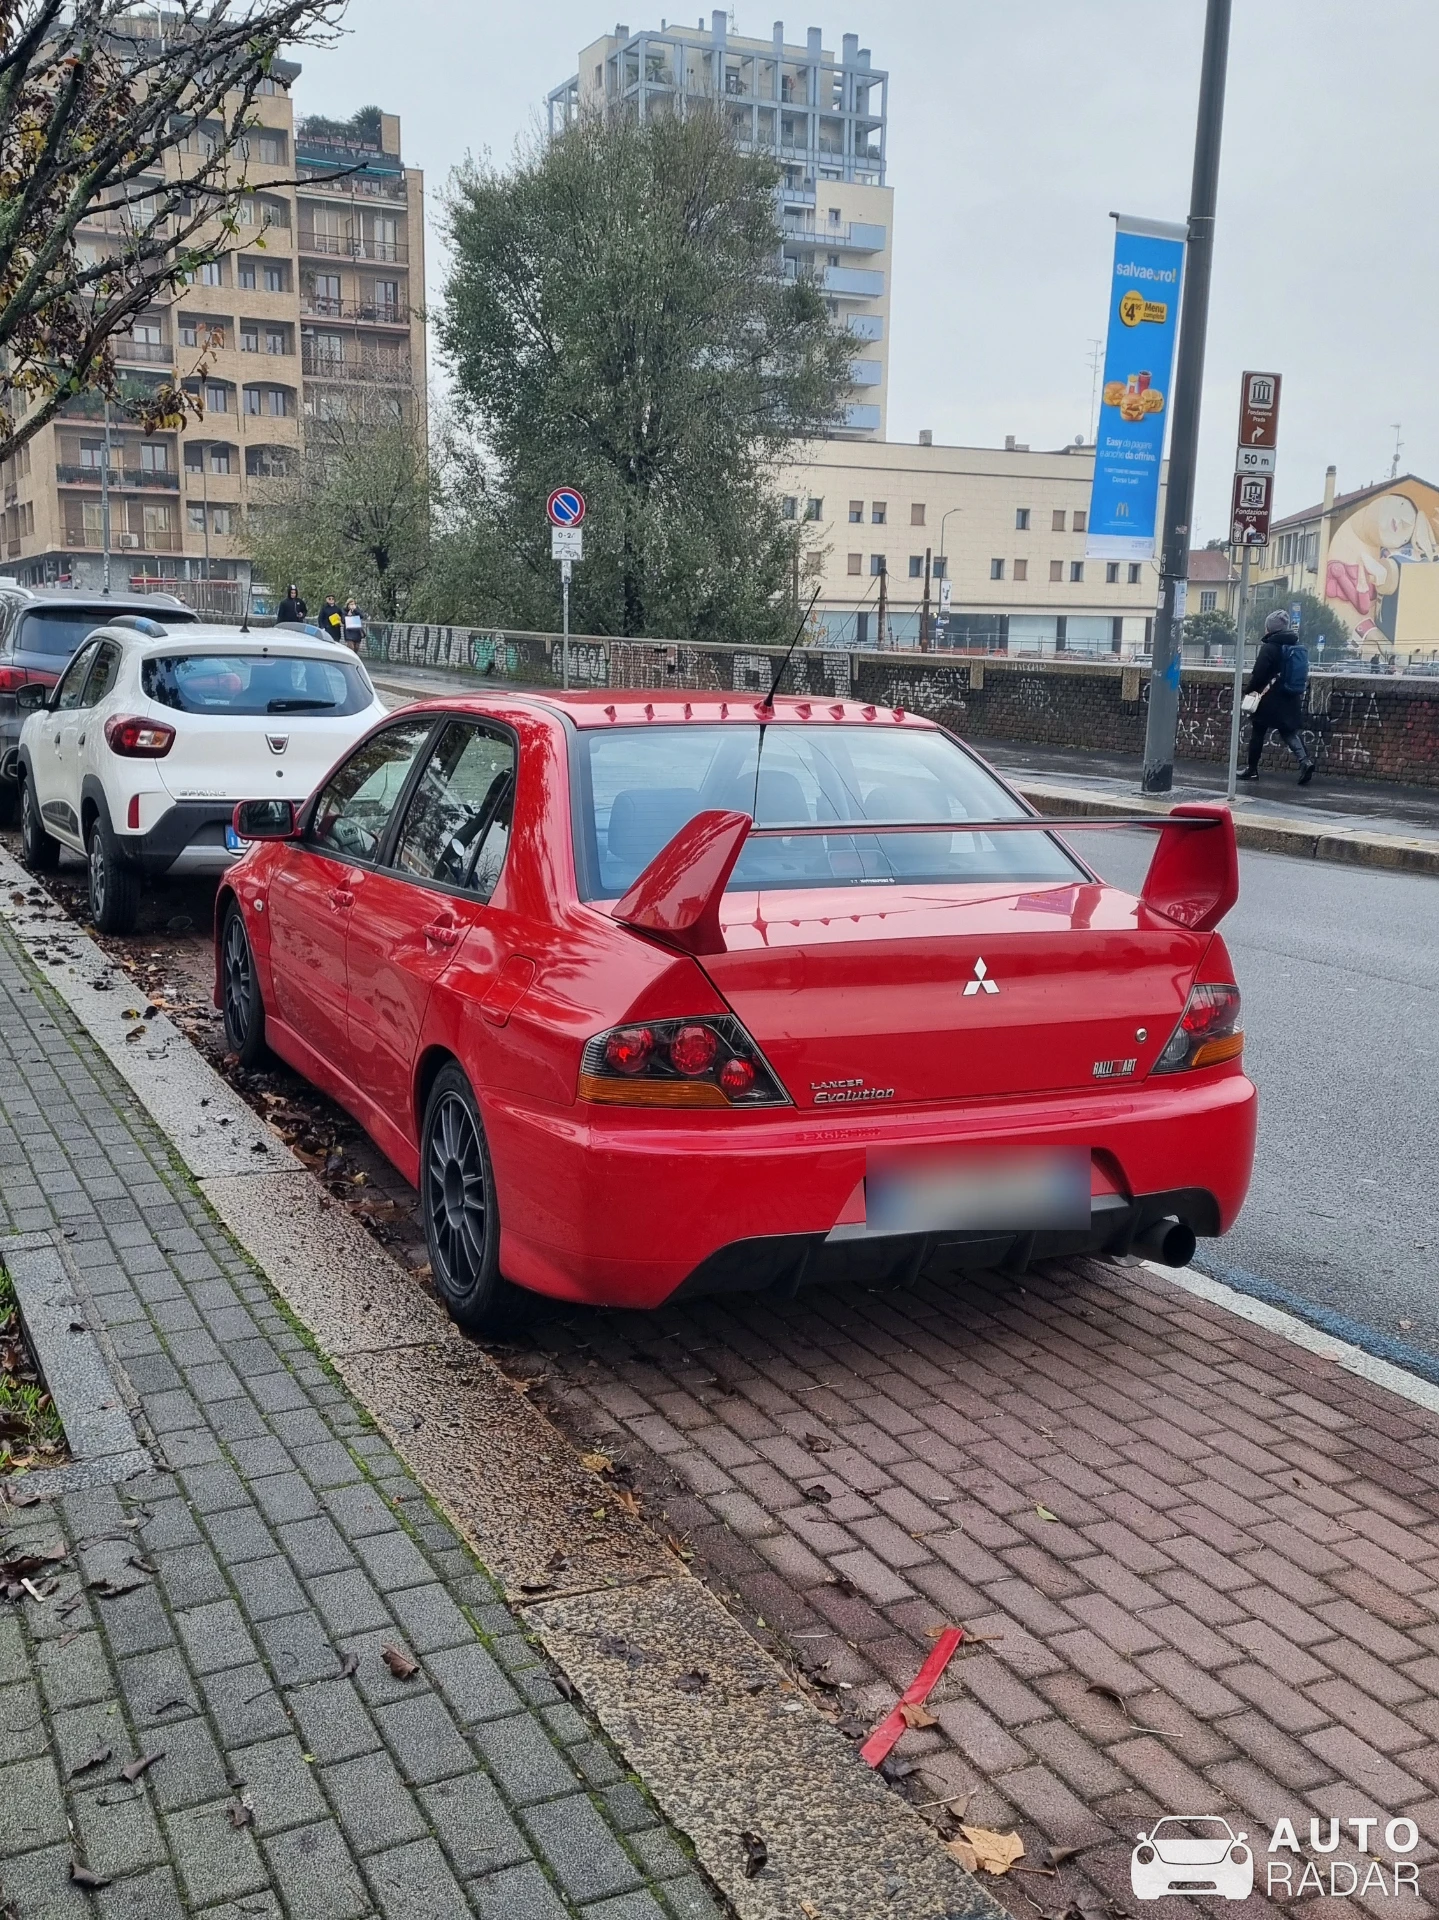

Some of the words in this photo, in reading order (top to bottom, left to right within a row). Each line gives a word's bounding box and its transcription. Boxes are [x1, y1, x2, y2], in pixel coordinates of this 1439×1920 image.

[1144, 302, 1165, 313] Menu
[1106, 436, 1123, 449] Easy
[1244, 454, 1258, 465] 50
[1235, 508, 1268, 517] Fondazione
[811, 1079, 864, 1090] LANCER
[813, 1087, 895, 1104] Evolution
